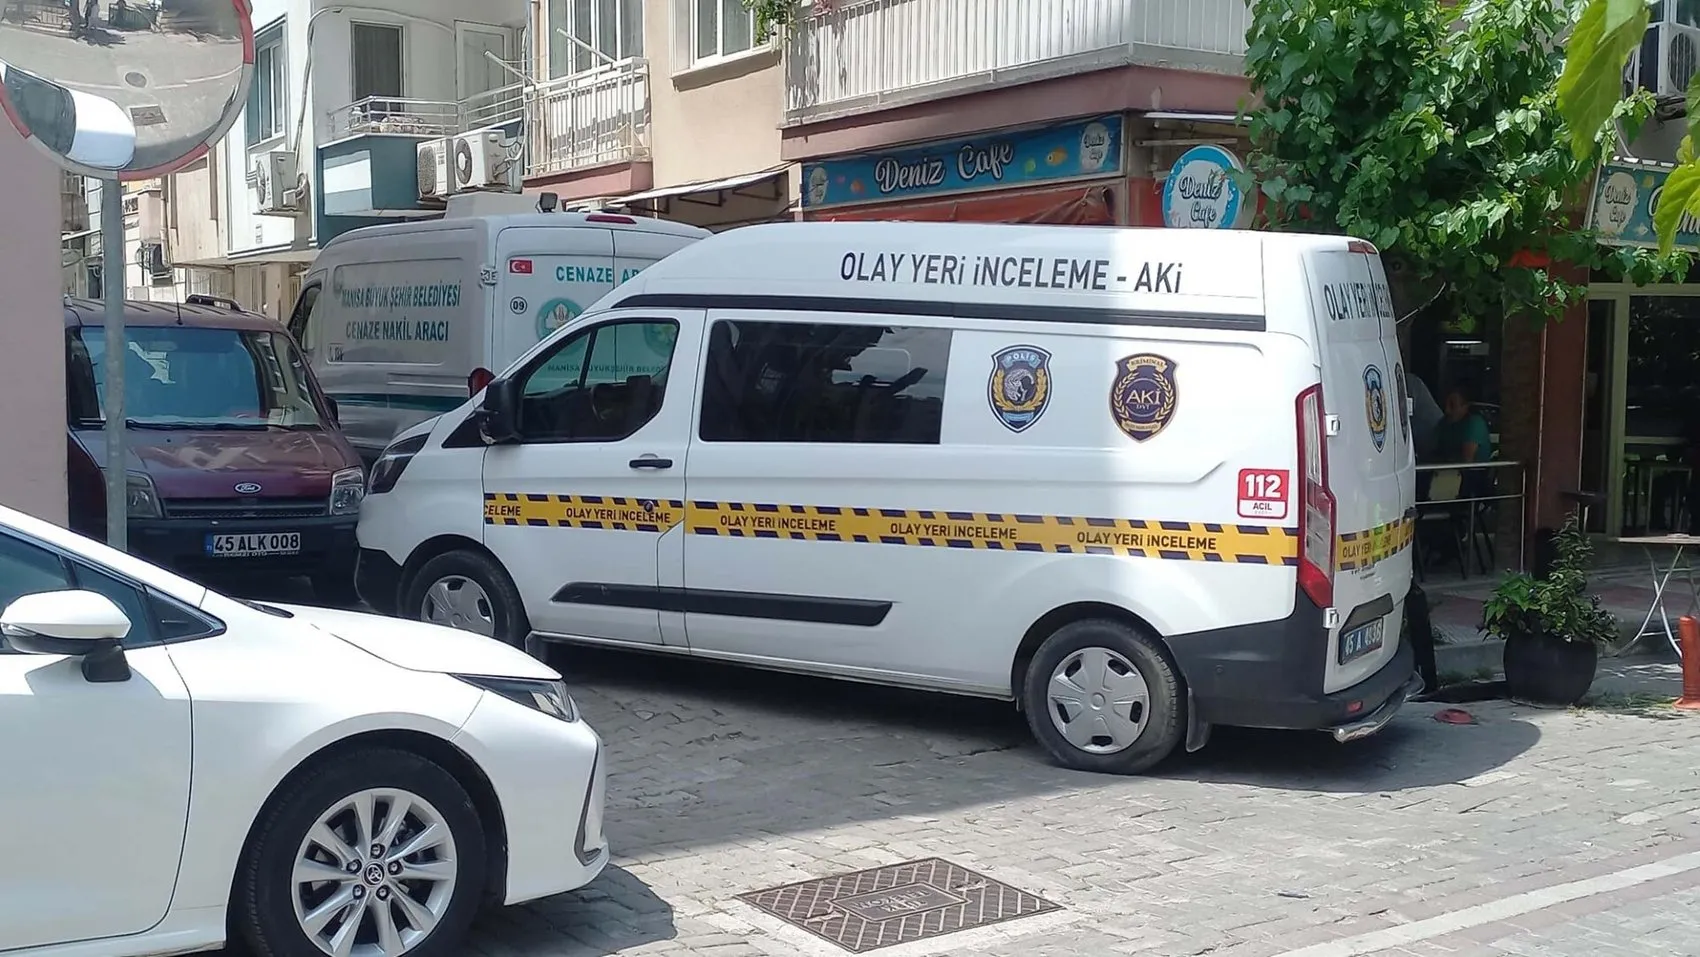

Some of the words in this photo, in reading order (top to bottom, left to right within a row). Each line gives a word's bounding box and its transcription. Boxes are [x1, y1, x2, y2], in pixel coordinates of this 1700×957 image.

[875, 157, 945, 193] Deniz
[957, 144, 1014, 180] Cafe
[1179, 174, 1223, 200] Deniz
[1190, 201, 1218, 228] Cafe
[556, 266, 613, 283] CENAZE
[840, 252, 905, 282] OLAY
[412, 280, 462, 308] BELEDİYESİ
[512, 302, 525, 311] 09
[346, 321, 380, 340] CENAZE
[382, 316, 412, 341] NAKİL
[414, 320, 449, 341] ARACI
[1245, 473, 1282, 498] 112
[566, 507, 592, 519] OLAY
[720, 515, 749, 527] OLAY
[890, 523, 921, 534] OLAY
[1077, 532, 1111, 544] OLAY
[215, 536, 235, 551] 45
[238, 535, 267, 551] ALK
[270, 534, 299, 550] 008
